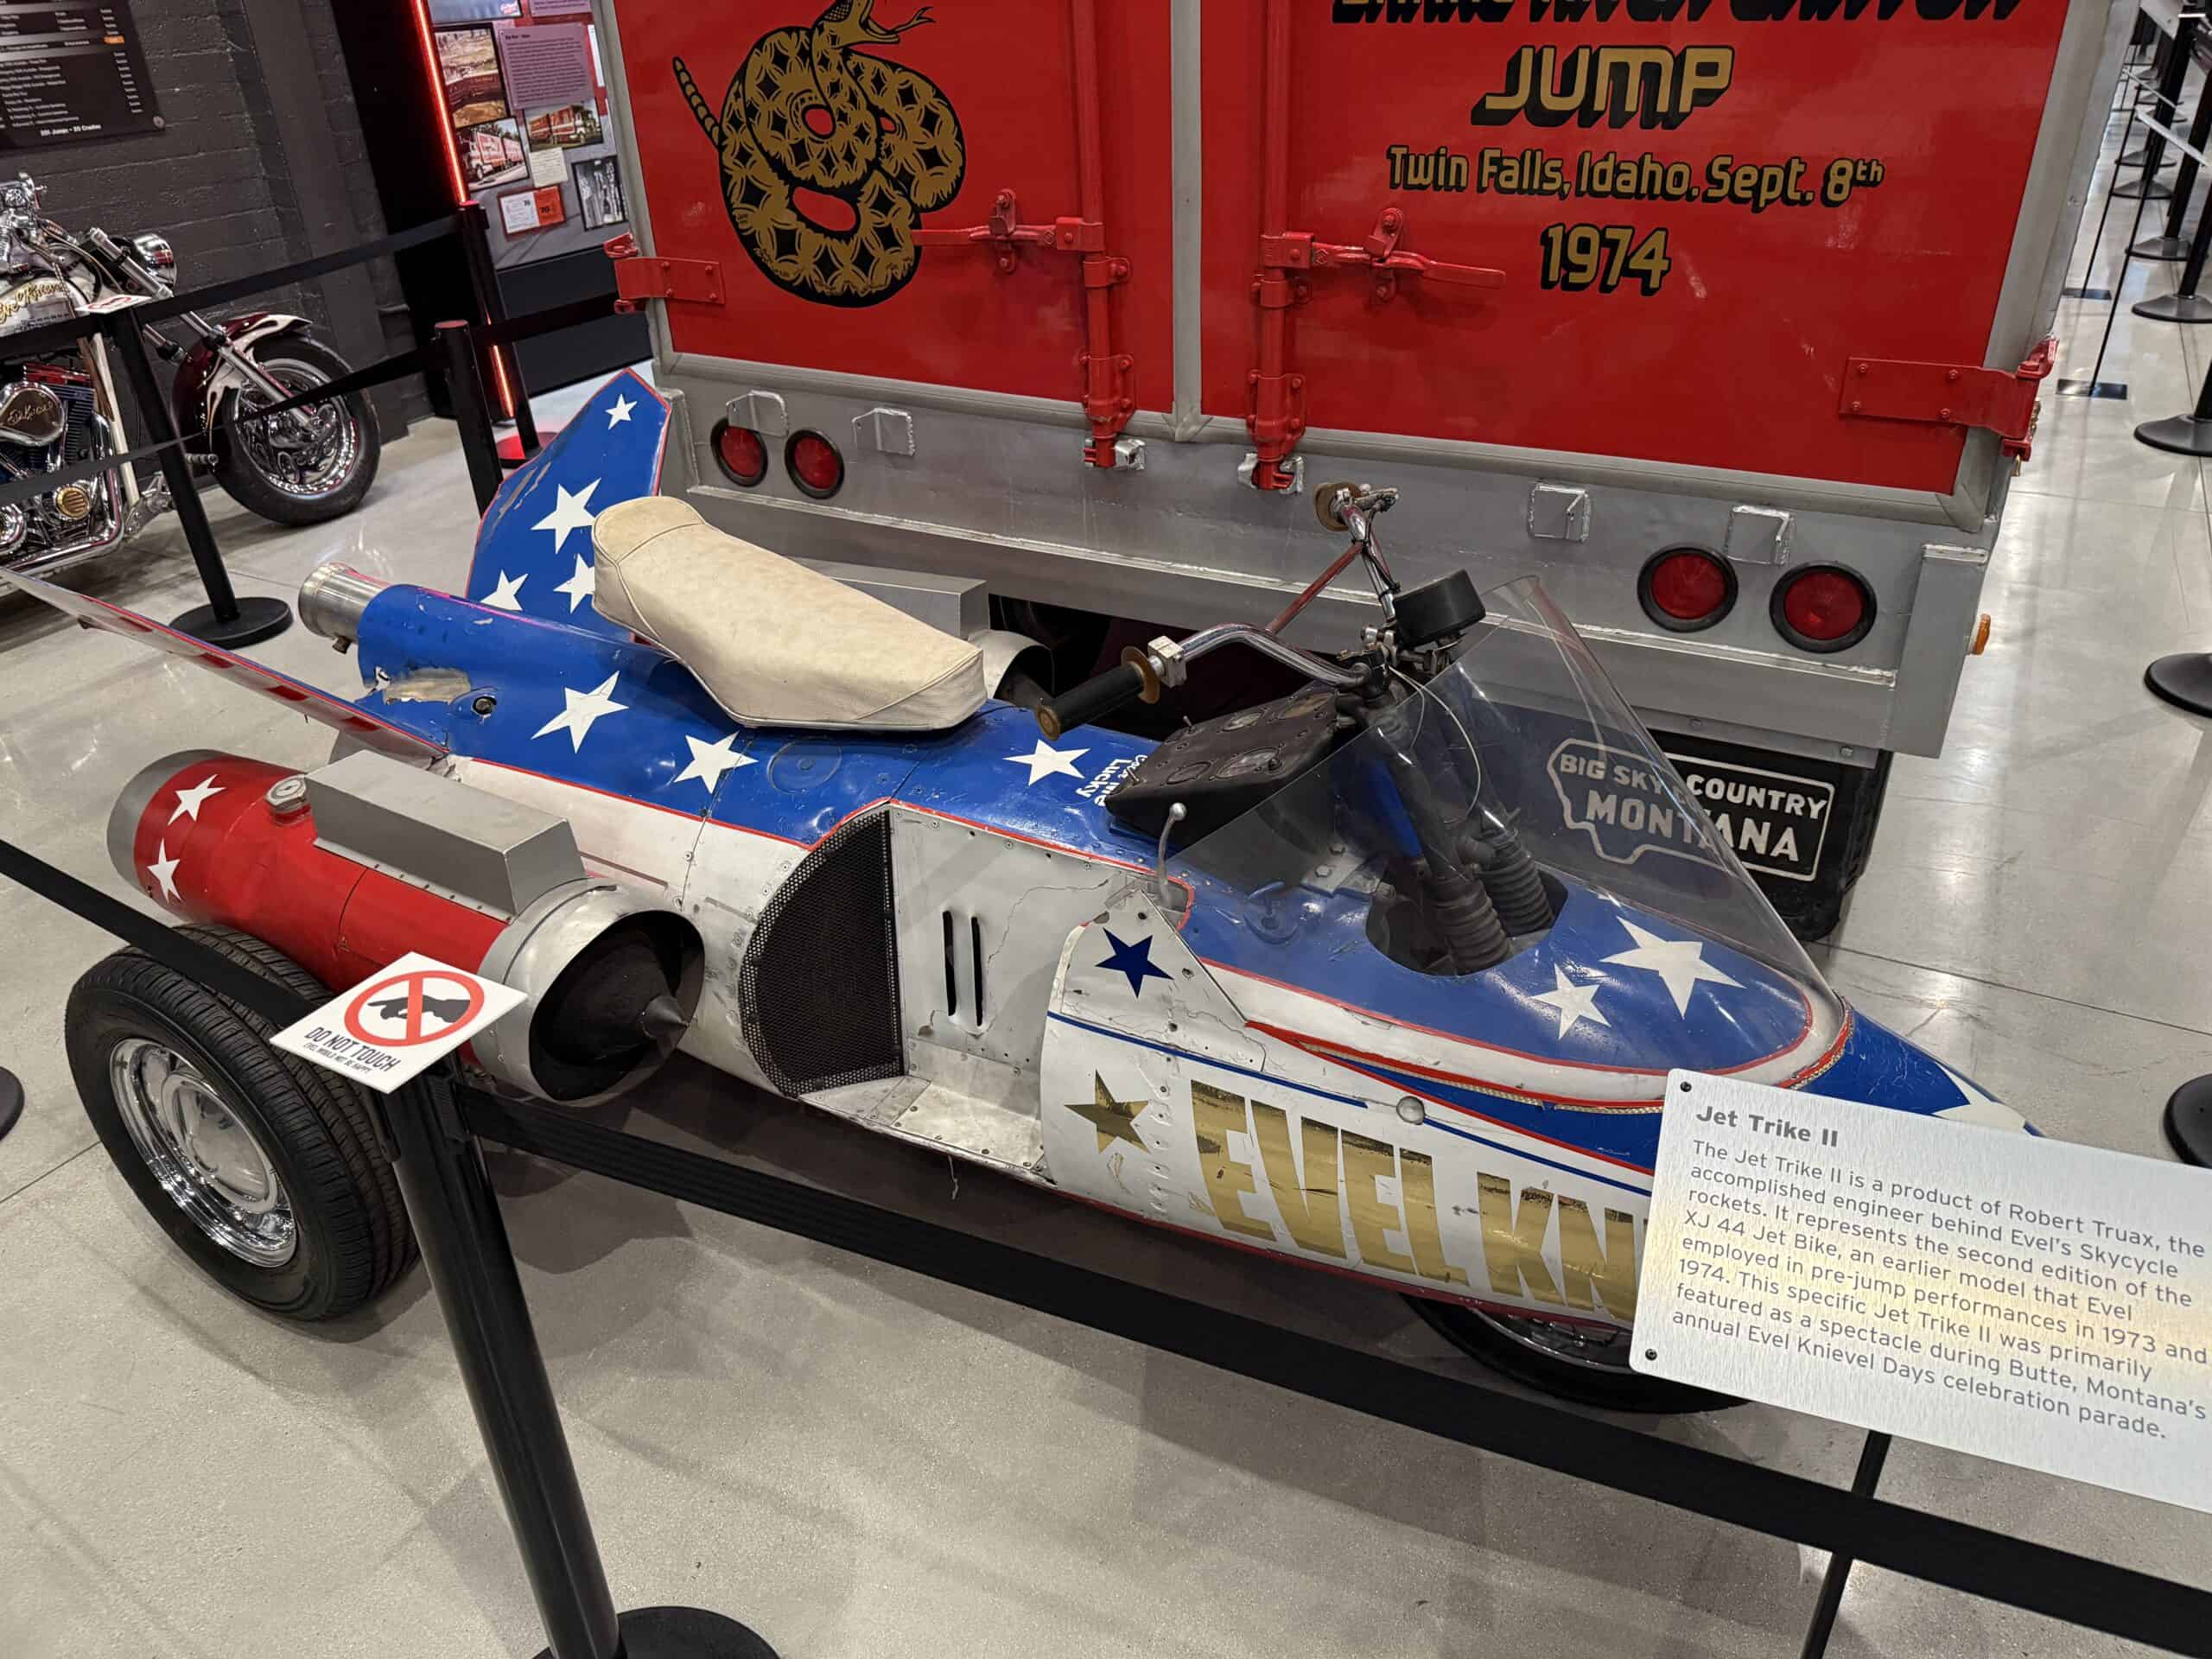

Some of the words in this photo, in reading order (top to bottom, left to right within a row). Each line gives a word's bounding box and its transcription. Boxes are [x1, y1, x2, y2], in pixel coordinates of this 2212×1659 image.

[1471, 45, 1734, 130] JUMP
[1386, 145, 1468, 192] Twin
[1477, 149, 1572, 200] Falls,
[1702, 156, 1815, 213] Sept.
[1821, 158, 1885, 207] 8th
[1540, 223, 1670, 296] 1974
[1560, 753, 1606, 780] BIG
[1614, 766, 1664, 797] SKY
[1684, 773, 1828, 819] COUNTRY
[1586, 790, 1799, 862] MONTANA
[304, 1027, 332, 1042] DO
[323, 1034, 360, 1053] NOT
[350, 1045, 401, 1071] TOUCH
[1696, 1106, 1738, 1128] Jet
[1749, 1114, 1811, 1141] Trike
[1821, 1128, 1839, 1147] II
[1191, 1079, 1469, 1288] EVEL
[1690, 1166, 1826, 1205] accomplished
[1834, 1195, 1923, 1222] engineer
[1932, 1211, 2002, 1242] behind
[2011, 1230, 2072, 1255] Evel's
[2080, 1243, 2178, 1278] Skycycle
[1694, 1140, 1728, 1160] The
[1735, 1150, 1768, 1168] Jet
[1775, 1156, 1823, 1179] Trike
[1830, 1168, 1841, 1183] II
[1849, 1172, 1865, 1188] is
[1872, 1179, 1884, 1192] a
[1891, 1182, 1973, 1211] product
[1980, 1200, 2001, 1216] of
[2009, 1204, 2084, 1233] Robert
[2092, 1220, 2160, 1251] Truax,
[2168, 1236, 2205, 1257] the
[1682, 1236, 1779, 1268] employed
[1787, 1255, 1803, 1274] in
[1812, 1266, 1906, 1299] pre-jump
[1914, 1287, 2067, 1333] performances
[2075, 1319, 2094, 1339] in
[2102, 1326, 2157, 1353] 1973
[2164, 1344, 2207, 1363] and
[1684, 1209, 1709, 1229] XJ
[1717, 1217, 1745, 1236] 44
[1752, 1225, 1787, 1245] Jet
[1795, 1233, 1842, 1260] Bike,
[1850, 1249, 1874, 1264] an
[1882, 1254, 1951, 1281] earlier
[1960, 1273, 2024, 1296] model
[2033, 1284, 2078, 1310] that
[2088, 1297, 2133, 1320] Evel
[1688, 1189, 1767, 1217] rockets.
[1775, 1205, 1789, 1221] It
[1796, 1211, 1908, 1247] represents
[1915, 1235, 1949, 1255] the
[1956, 1245, 2032, 1274] second
[2042, 1265, 2117, 1291] edition
[2126, 1281, 2146, 1297] of
[2154, 1285, 2192, 1307] the
[1673, 1310, 1740, 1338] annual
[1748, 1325, 1789, 1350] Evel
[1797, 1337, 1875, 1370] Knievel
[1883, 1357, 1936, 1385] Days
[1944, 1375, 2070, 1416] celebration
[2079, 1406, 2167, 1439] parade.
[1676, 1282, 1763, 1316] featured
[1770, 1307, 1793, 1324] as
[1800, 1314, 1812, 1328] a
[1820, 1319, 1923, 1353] spectacle
[1930, 1342, 2000, 1375] during
[2009, 1358, 2077, 1393] Butte,
[2087, 1376, 2206, 1420] Montana's
[1679, 1258, 1731, 1283] 1974.
[1738, 1272, 1779, 1294] This
[1787, 1285, 1866, 1314] specific
[1874, 1303, 1910, 1324] Jet
[1917, 1311, 1970, 1338] Trike
[1979, 1325, 1990, 1343] II
[2000, 1332, 2041, 1354] was
[2050, 1344, 2152, 1382] primarily
